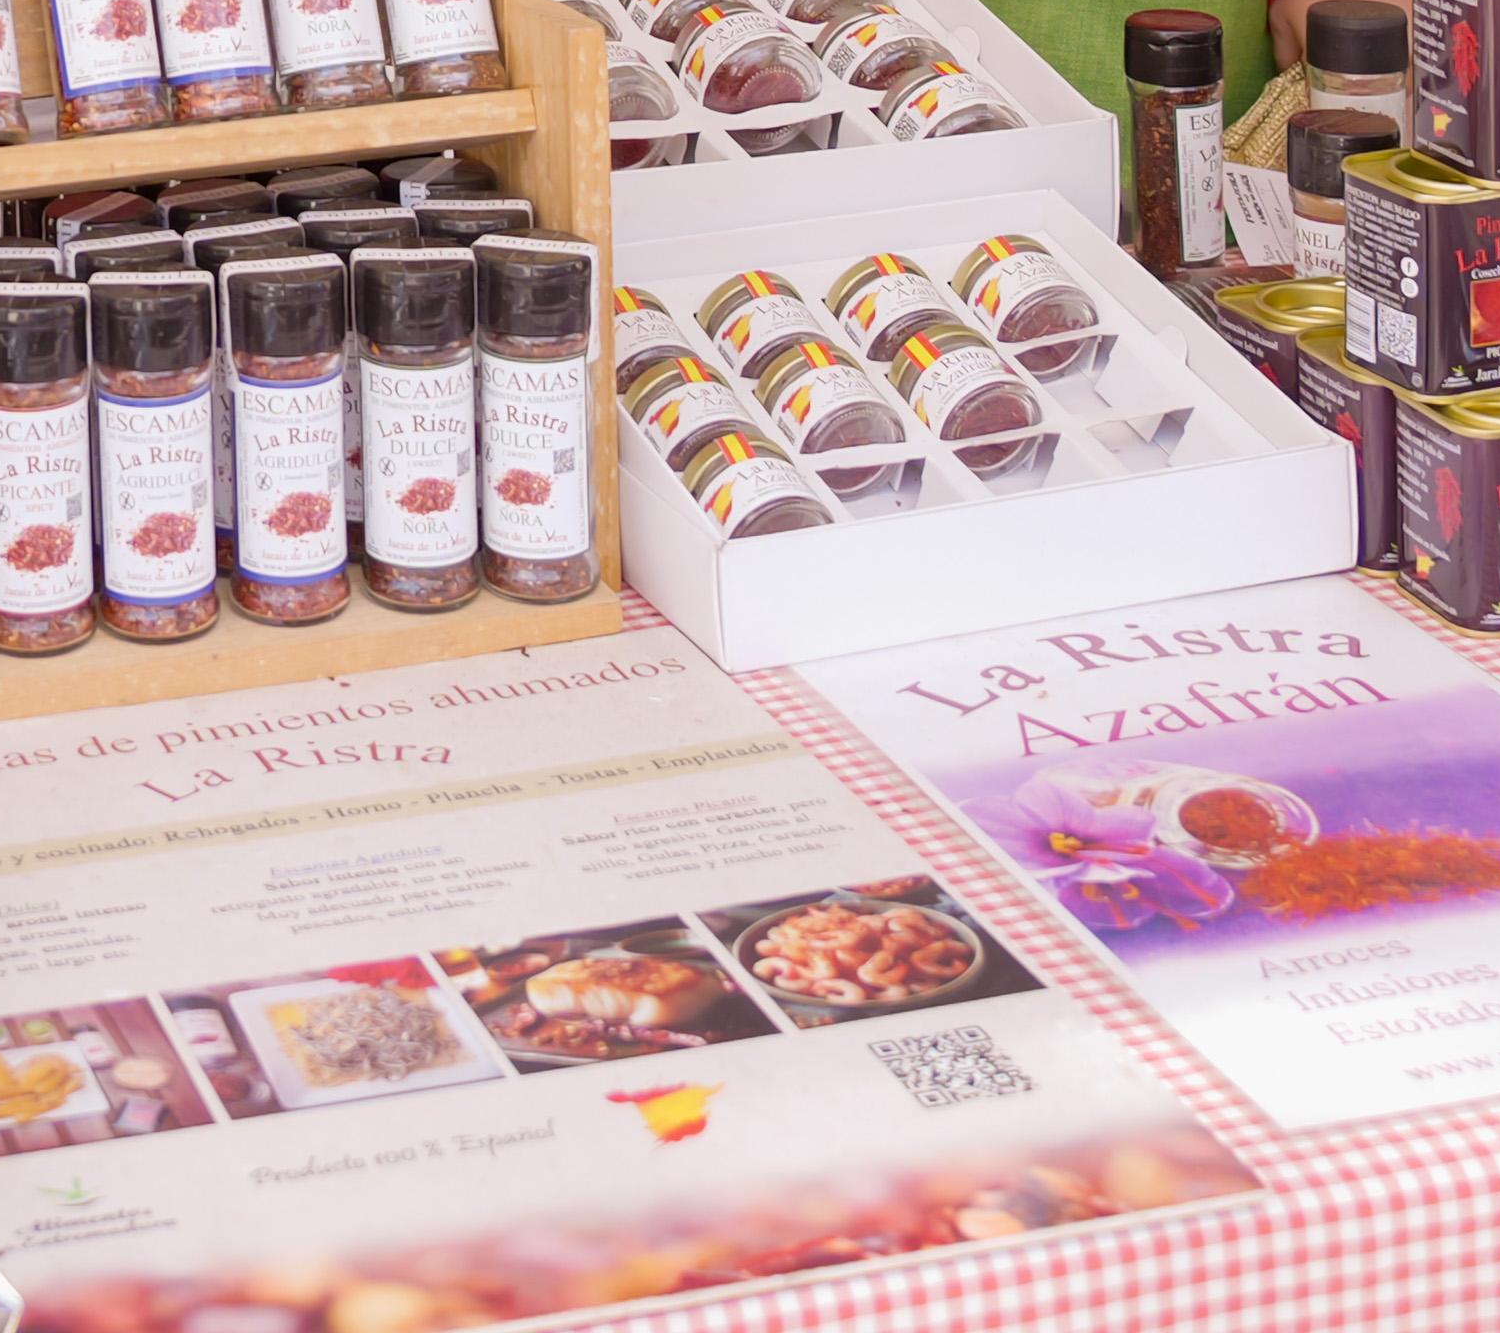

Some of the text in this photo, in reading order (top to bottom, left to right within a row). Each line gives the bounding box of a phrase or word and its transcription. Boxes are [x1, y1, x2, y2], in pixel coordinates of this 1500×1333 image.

[307, 16, 350, 36] ÑORA
[424, 7, 468, 25] ÑORA
[1305, 249, 1344, 276] Ristr
[941, 350, 991, 370] Ristra
[897, 620, 1372, 718] La Ristra
[77, 736, 137, 759] de
[156, 694, 414, 755] pimientos
[430, 655, 686, 709] ahumados
[1011, 667, 1398, 759] Azafrán
[138, 741, 453, 803] La Ristra
[11, 851, 24, 866] y
[163, 814, 300, 843] Rehogados
[325, 797, 402, 821] Horno
[426, 782, 522, 805] Plancha
[552, 765, 628, 787] Tostas
[652, 740, 789, 772] Emplatados
[1258, 936, 1413, 981] Arroces
[1287, 959, 1500, 1013] Infusiones
